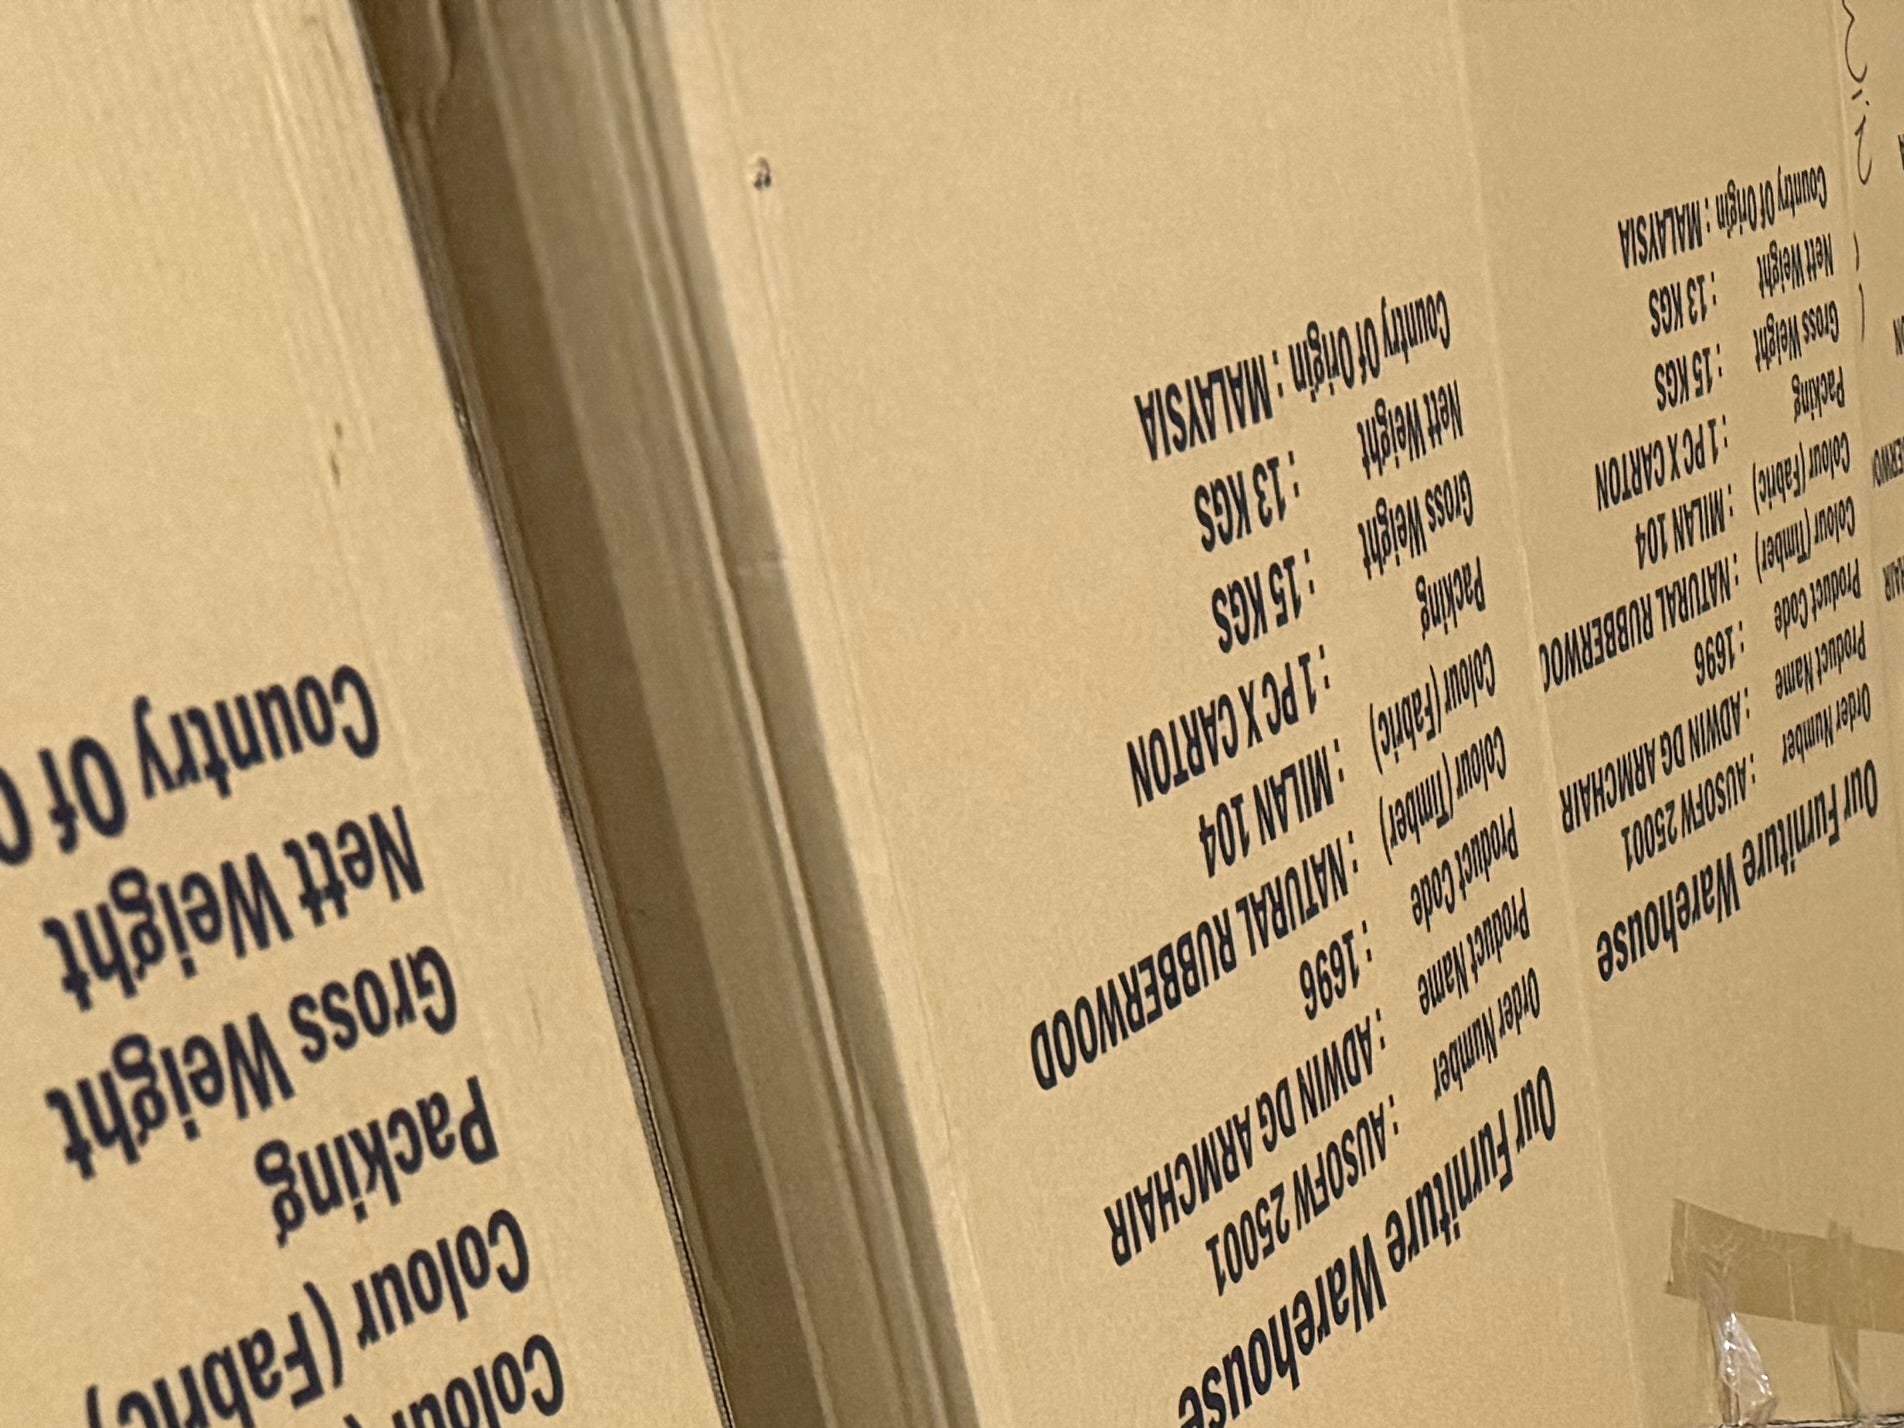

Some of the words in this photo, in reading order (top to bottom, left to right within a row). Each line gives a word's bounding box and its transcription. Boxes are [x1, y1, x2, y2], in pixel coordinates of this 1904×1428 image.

[1716, 179, 1757, 239] Origin
[1760, 180, 1775, 229] Of
[1778, 166, 1827, 217] Country
[1618, 200, 1702, 268] MALAYSIA
[1288, 321, 1354, 402] Origin
[1356, 317, 1380, 385] Of
[1381, 291, 1450, 364] Country
[1134, 355, 1273, 461] MALAYSIA
[1753, 442, 1805, 515] (Fabric)
[1809, 432, 1850, 480] Colour
[1635, 513, 1667, 570] 104
[1672, 488, 1725, 553] MILAN
[1415, 556, 1485, 640] Packing
[1298, 652, 1316, 714] 1
[1775, 652, 1814, 700] Name
[1815, 621, 1866, 685] Product
[133, 665, 379, 799] Country
[1238, 680, 1263, 748] X
[1262, 662, 1299, 735] PC
[1688, 691, 1740, 762] ADWIN
[1783, 705, 1834, 765] Number
[1836, 683, 1870, 732] Order
[1127, 694, 1238, 807] CARTON
[1455, 726, 1506, 799] Colour
[1559, 738, 1655, 833] ARMCHAIR
[1660, 724, 1685, 776] DG
[1844, 760, 1878, 821] Our
[38, 737, 127, 854] Of
[1379, 752, 1453, 866] (Timber)
[1621, 800, 1677, 872] 25001
[1681, 757, 1746, 838] AUSOFW
[1742, 784, 1840, 886] Furniture
[283, 805, 424, 927] Nett
[1235, 838, 1348, 956] NATURAL
[42, 853, 294, 1012] Weight
[1466, 887, 1530, 984] Product
[1597, 852, 1740, 982] Warehouse
[288, 946, 456, 1063] Gross
[1031, 908, 1237, 1090] RUBBERWOOD
[1418, 941, 1469, 1015] Name
[1498, 968, 1540, 1039] Order
[1296, 1016, 1372, 1125] ADWIN
[1433, 1007, 1498, 1101] Number
[45, 1012, 294, 1180] Weight
[1256, 1077, 1296, 1152] DG
[1514, 1066, 1555, 1153] Our
[255, 1076, 498, 1248] Packing
[1104, 1105, 1252, 1266] ARMCHAIR
[1293, 1102, 1386, 1231] AUSOFW
[1386, 1109, 1513, 1272] Furniture
[352, 1209, 529, 1350] Colour
[1205, 1182, 1290, 1296] 25001
